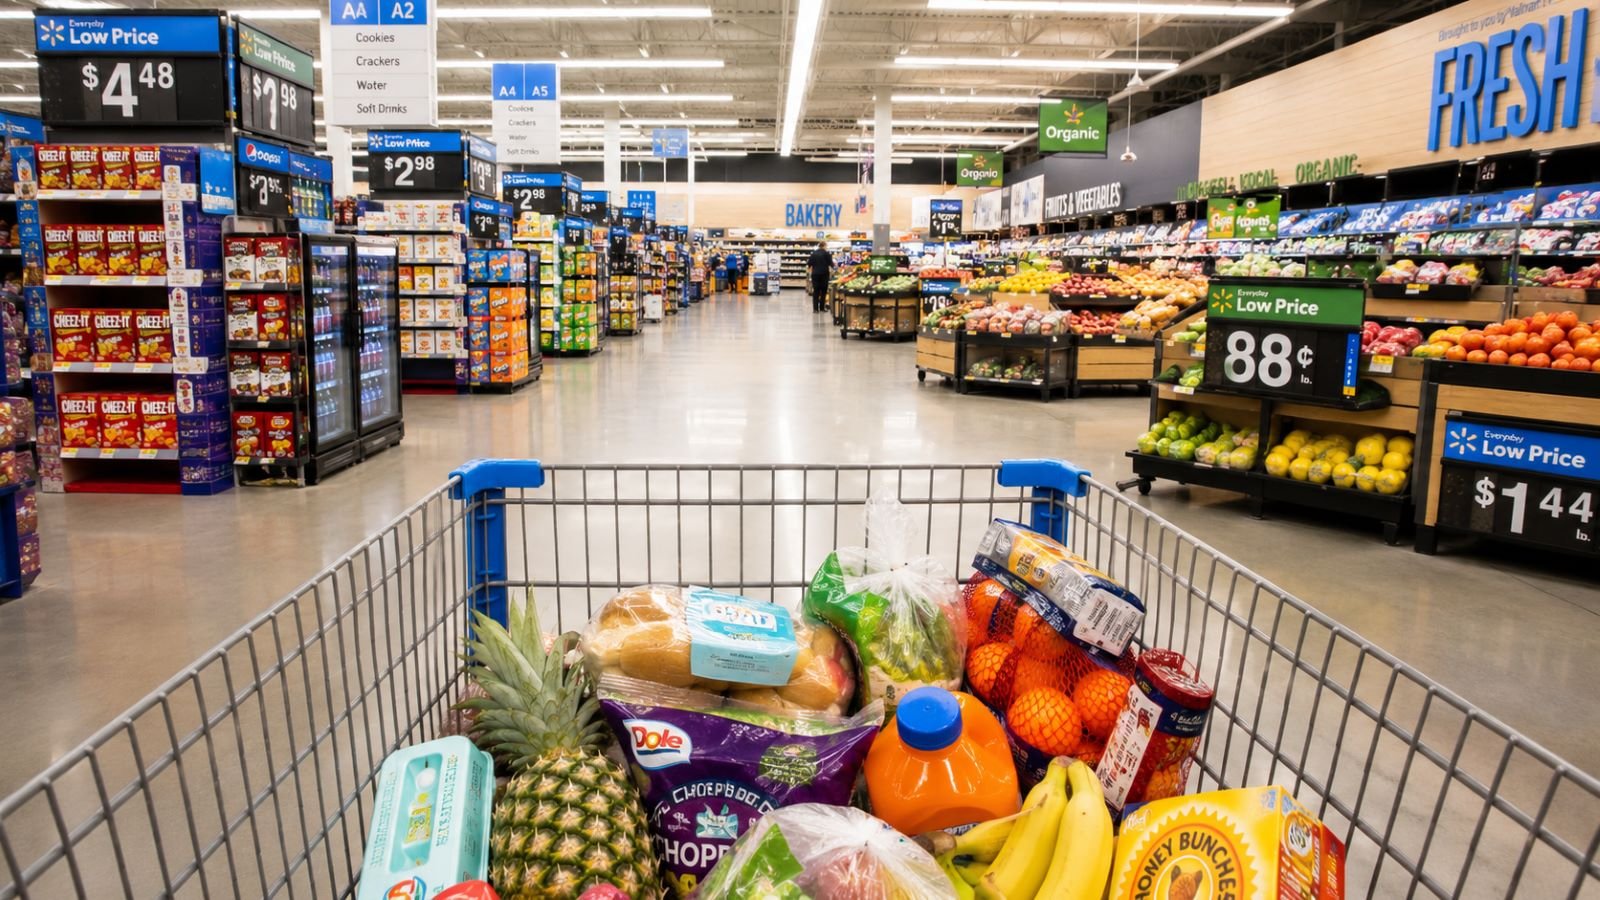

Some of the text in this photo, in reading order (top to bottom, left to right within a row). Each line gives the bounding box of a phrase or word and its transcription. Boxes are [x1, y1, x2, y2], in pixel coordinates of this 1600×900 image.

[391, 2, 414, 19] A2
[70, 27, 159, 45] Low Price
[356, 33, 395, 43] Cookies
[356, 56, 400, 67] Crackers
[1427, 7, 1589, 152] FRESH
[499, 86, 516, 97] A4
[532, 86, 549, 97] A5
[357, 104, 376, 114] Soft
[1046, 125, 1100, 143] Organic
[384, 139, 405, 148] Low
[785, 203, 842, 228] BAKERY
[1236, 297, 1319, 316] Low Price
[1482, 440, 1586, 468] Low Price
[631, 726, 683, 749] Dole
